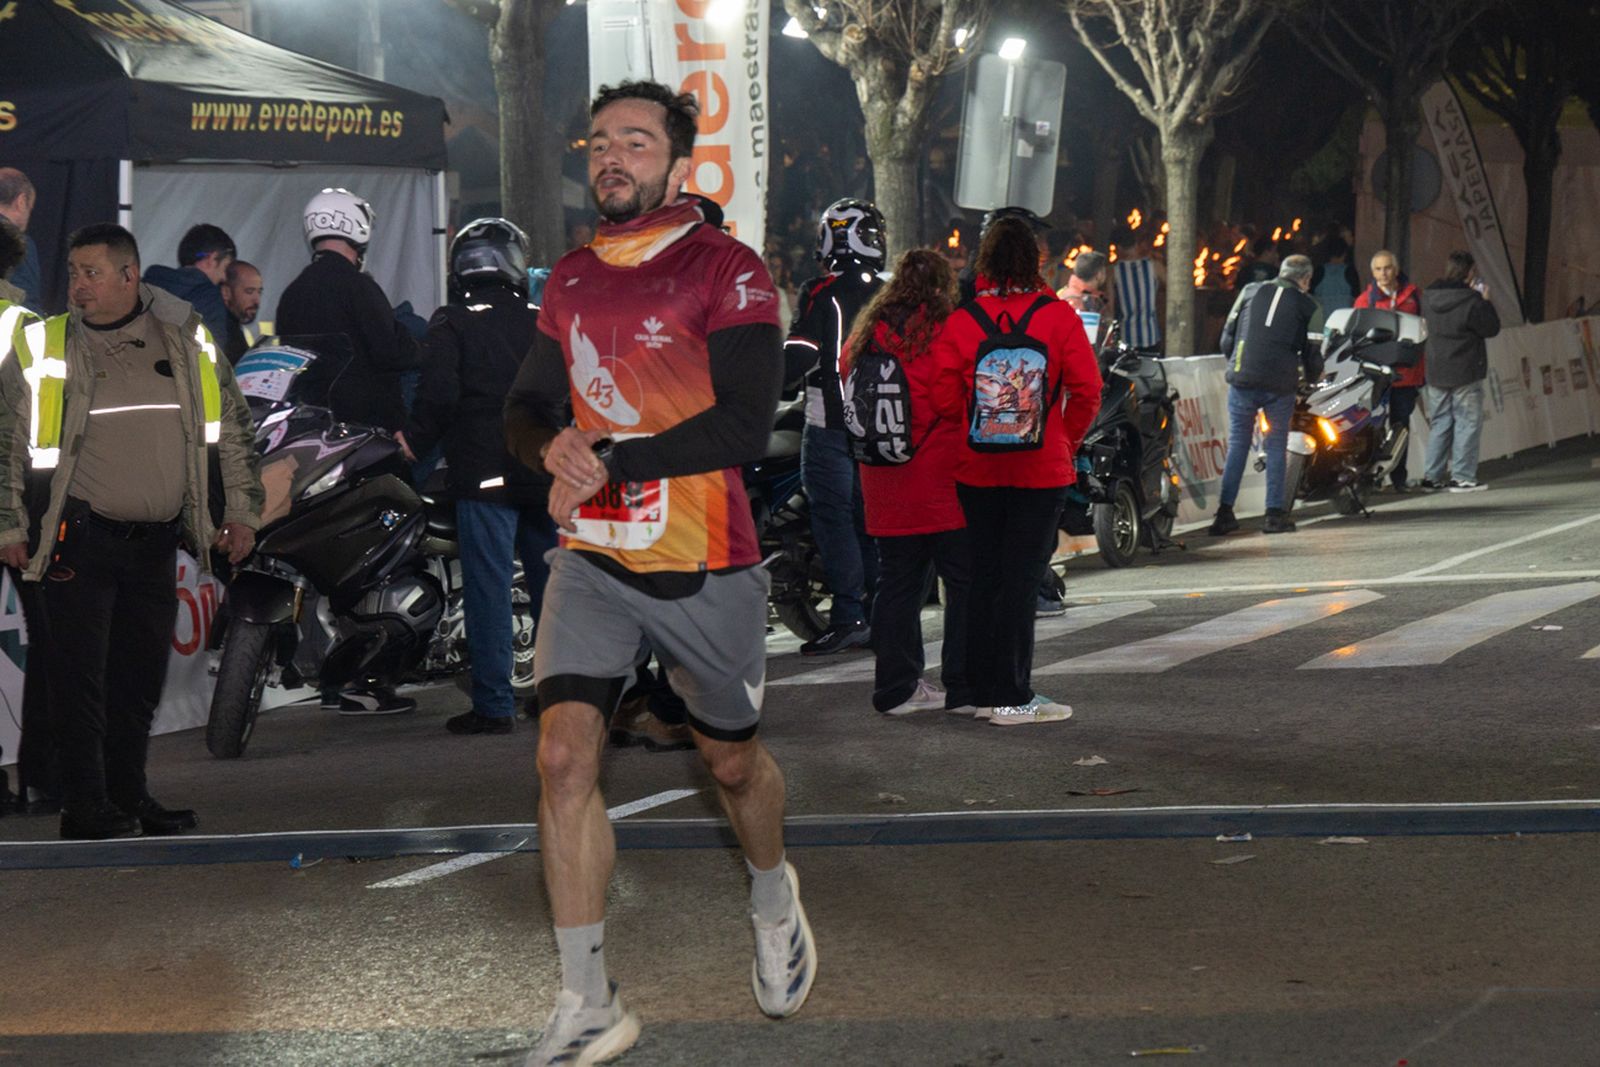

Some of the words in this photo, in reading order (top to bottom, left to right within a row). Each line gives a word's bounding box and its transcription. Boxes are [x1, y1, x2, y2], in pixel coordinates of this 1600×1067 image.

[191, 102, 404, 142] www.evedeport.es
[586, 377, 614, 409] 43
[1177, 397, 1204, 437] SAN
[1187, 427, 1228, 479] ANTÓ
